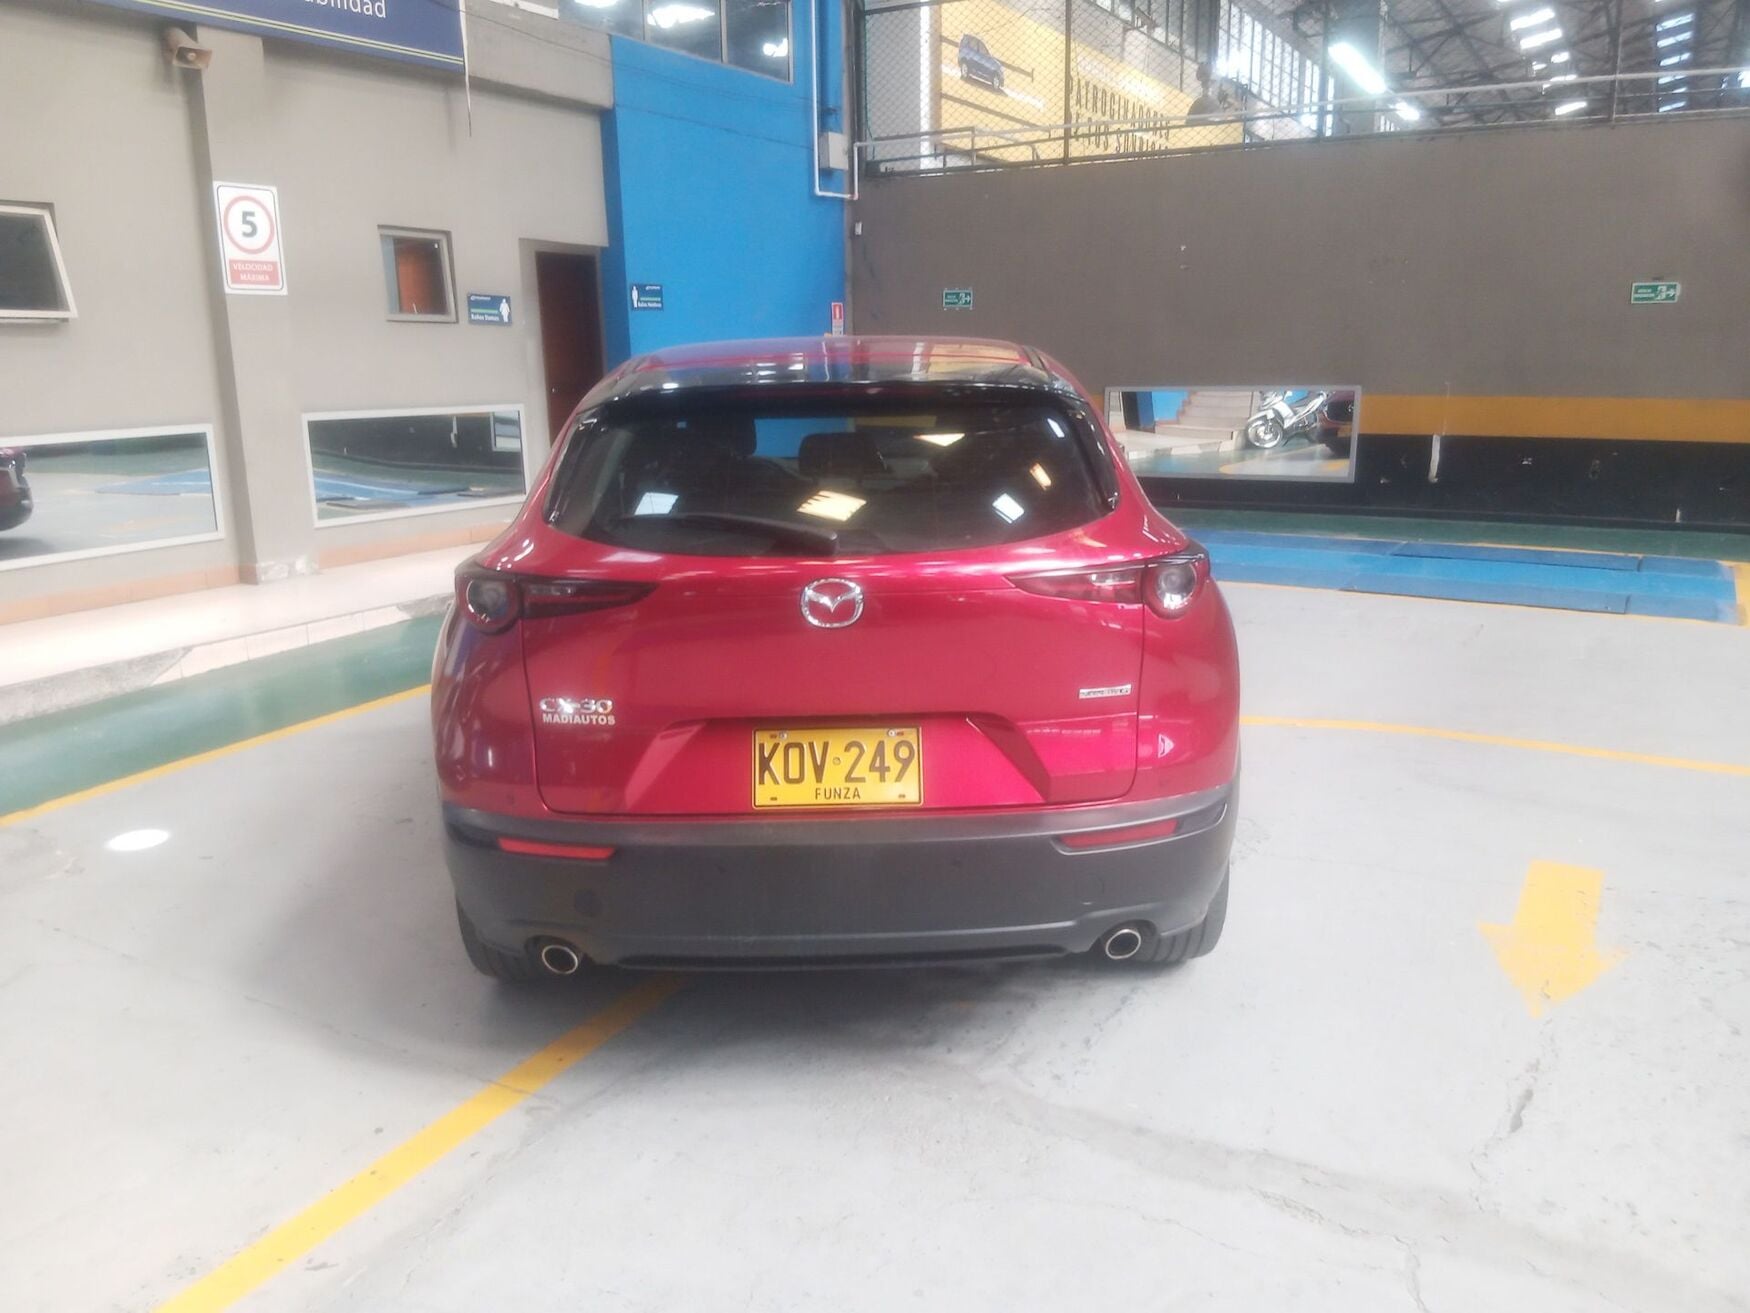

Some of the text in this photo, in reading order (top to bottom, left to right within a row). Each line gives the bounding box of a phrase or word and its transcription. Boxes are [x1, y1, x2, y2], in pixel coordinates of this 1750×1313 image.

[241, 210, 258, 238] 5
[232, 263, 274, 272] VELOCIDAD
[540, 697, 613, 714] CX-30
[542, 713, 616, 726] MADIAUTOS
[758, 740, 916, 785] KOV 249
[815, 787, 861, 800] FUNZA
